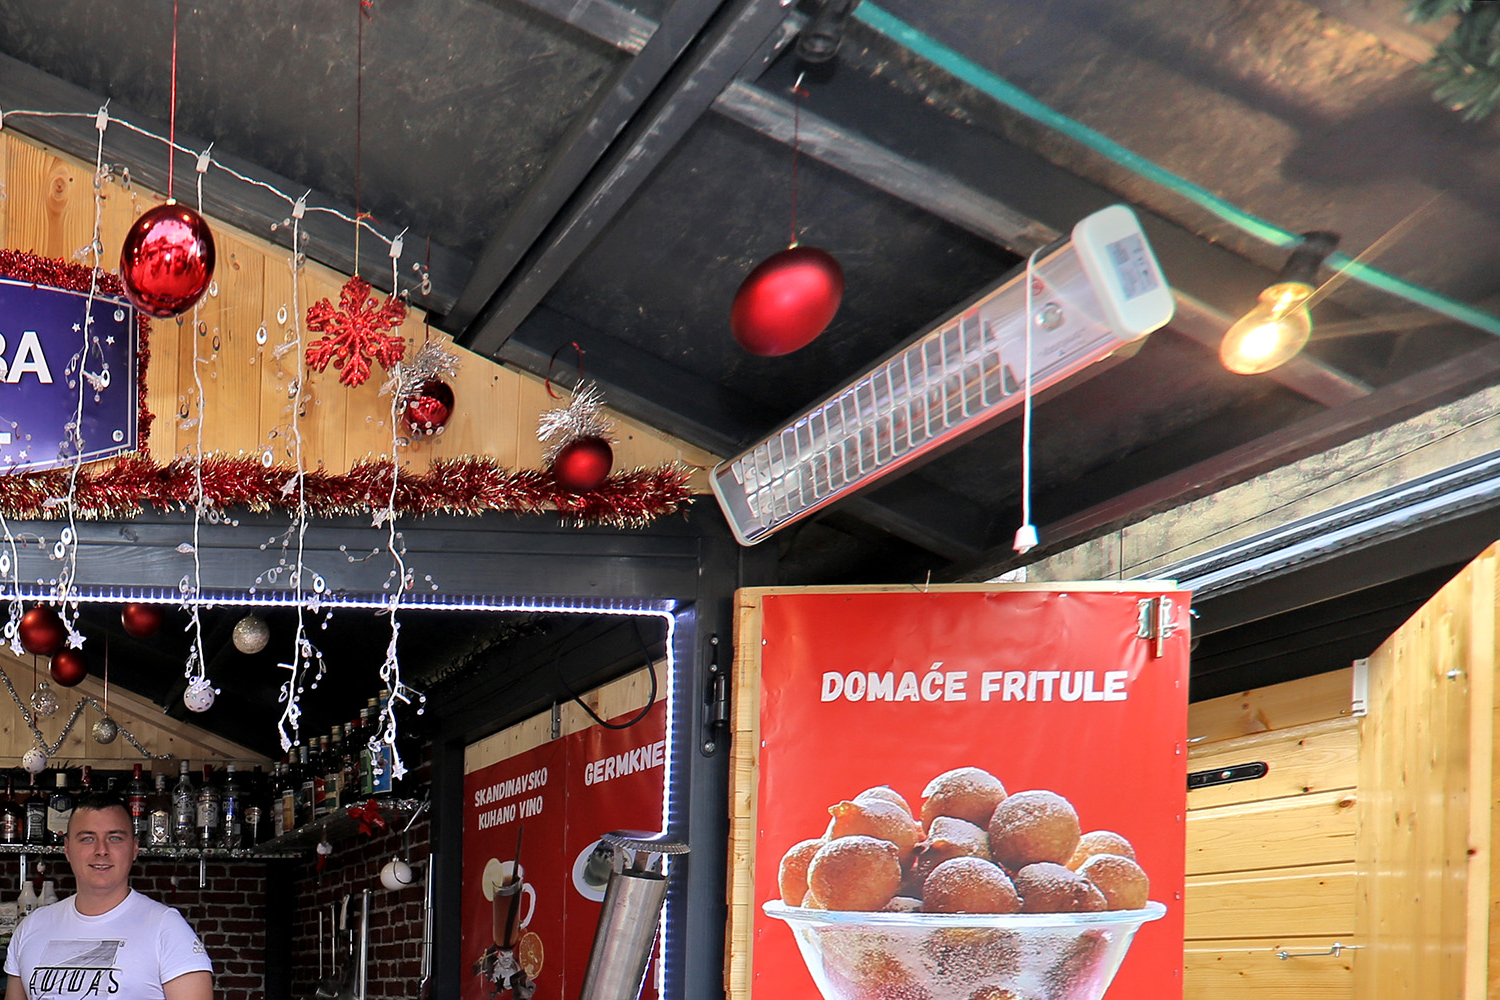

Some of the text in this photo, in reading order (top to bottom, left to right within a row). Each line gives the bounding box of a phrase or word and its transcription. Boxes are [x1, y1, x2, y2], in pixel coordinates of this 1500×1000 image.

[820, 662, 1129, 702] DOMAĆE FRITULE
[474, 766, 548, 808] SKANDINAVSKO
[478, 794, 544, 831] KUHANO VINO
